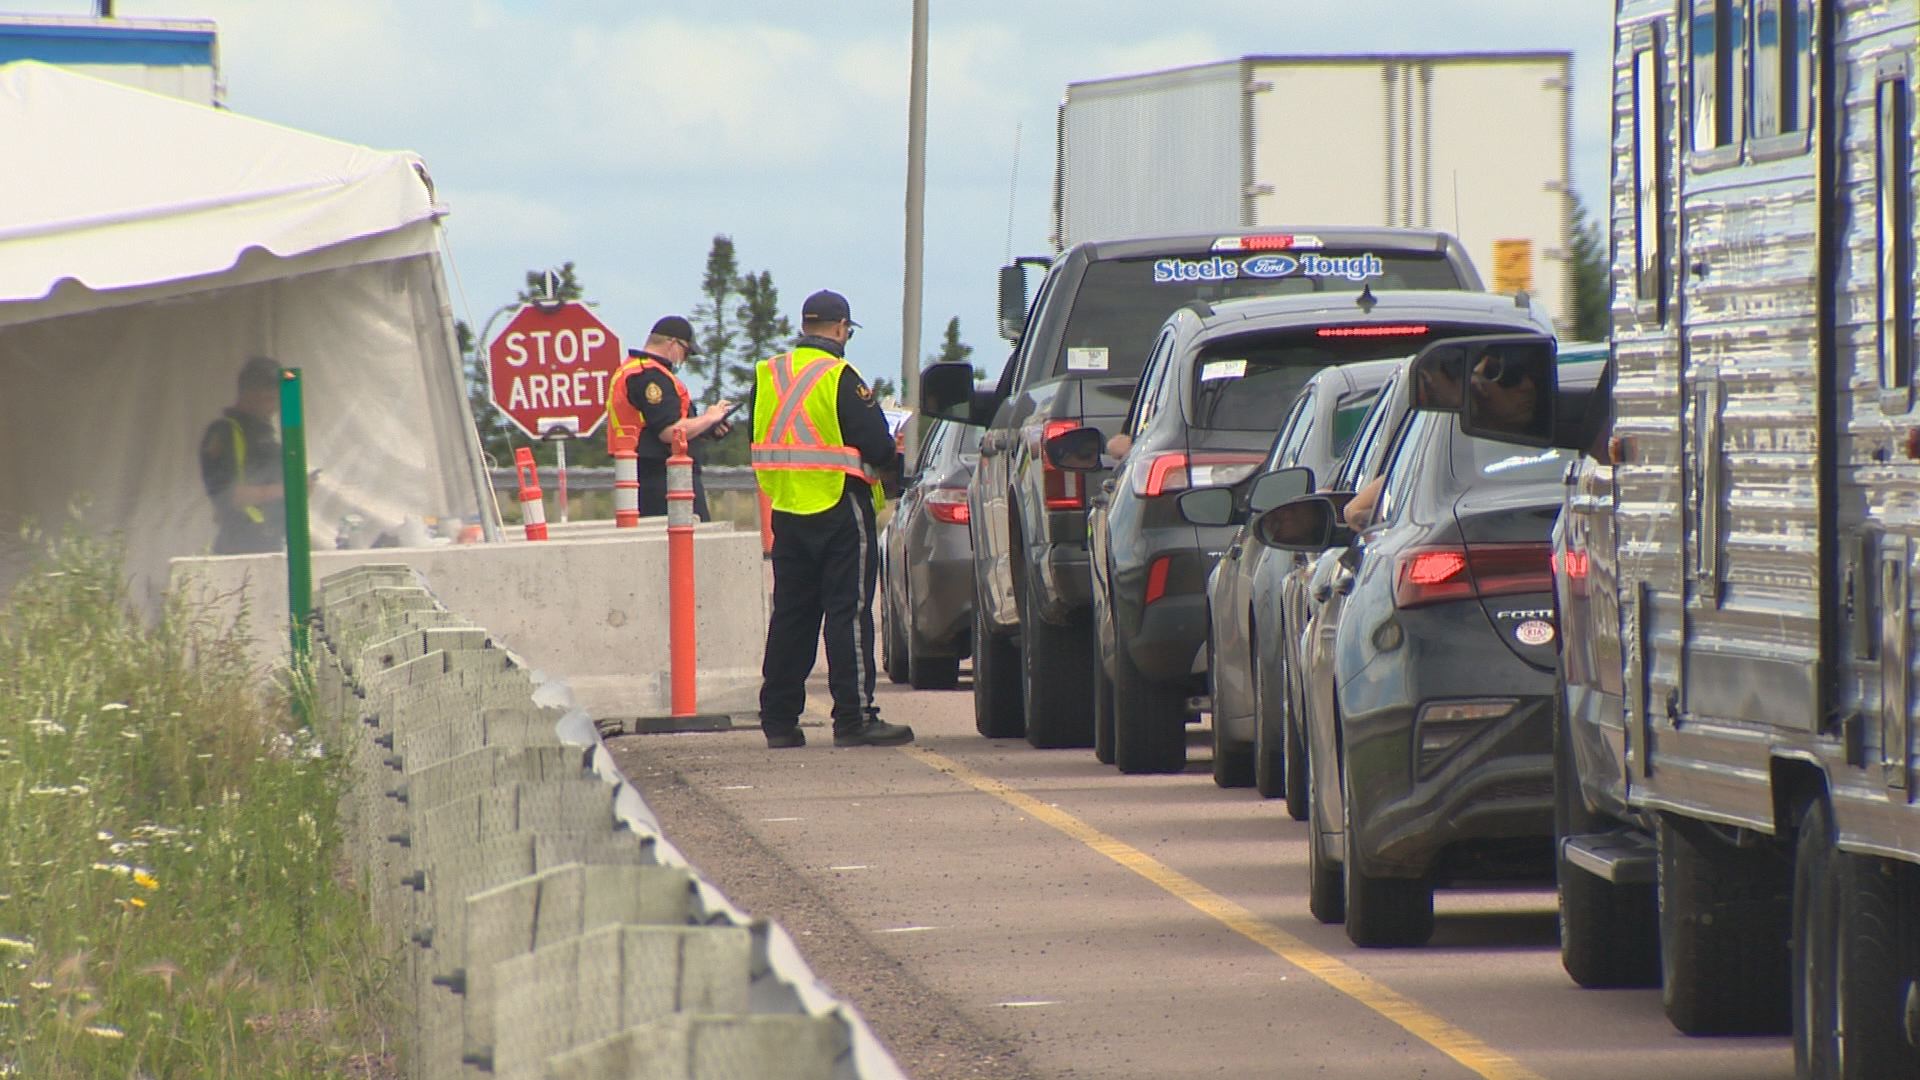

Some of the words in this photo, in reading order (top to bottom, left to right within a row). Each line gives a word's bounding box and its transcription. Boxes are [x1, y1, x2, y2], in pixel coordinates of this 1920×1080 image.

[1154, 257, 1238, 281] Steele
[1253, 259, 1286, 273] Ford
[1300, 253, 1383, 280] Tough
[505, 328, 605, 367] STOP
[509, 367, 609, 410] ARRÊT
[1527, 628, 1545, 637] KIA
